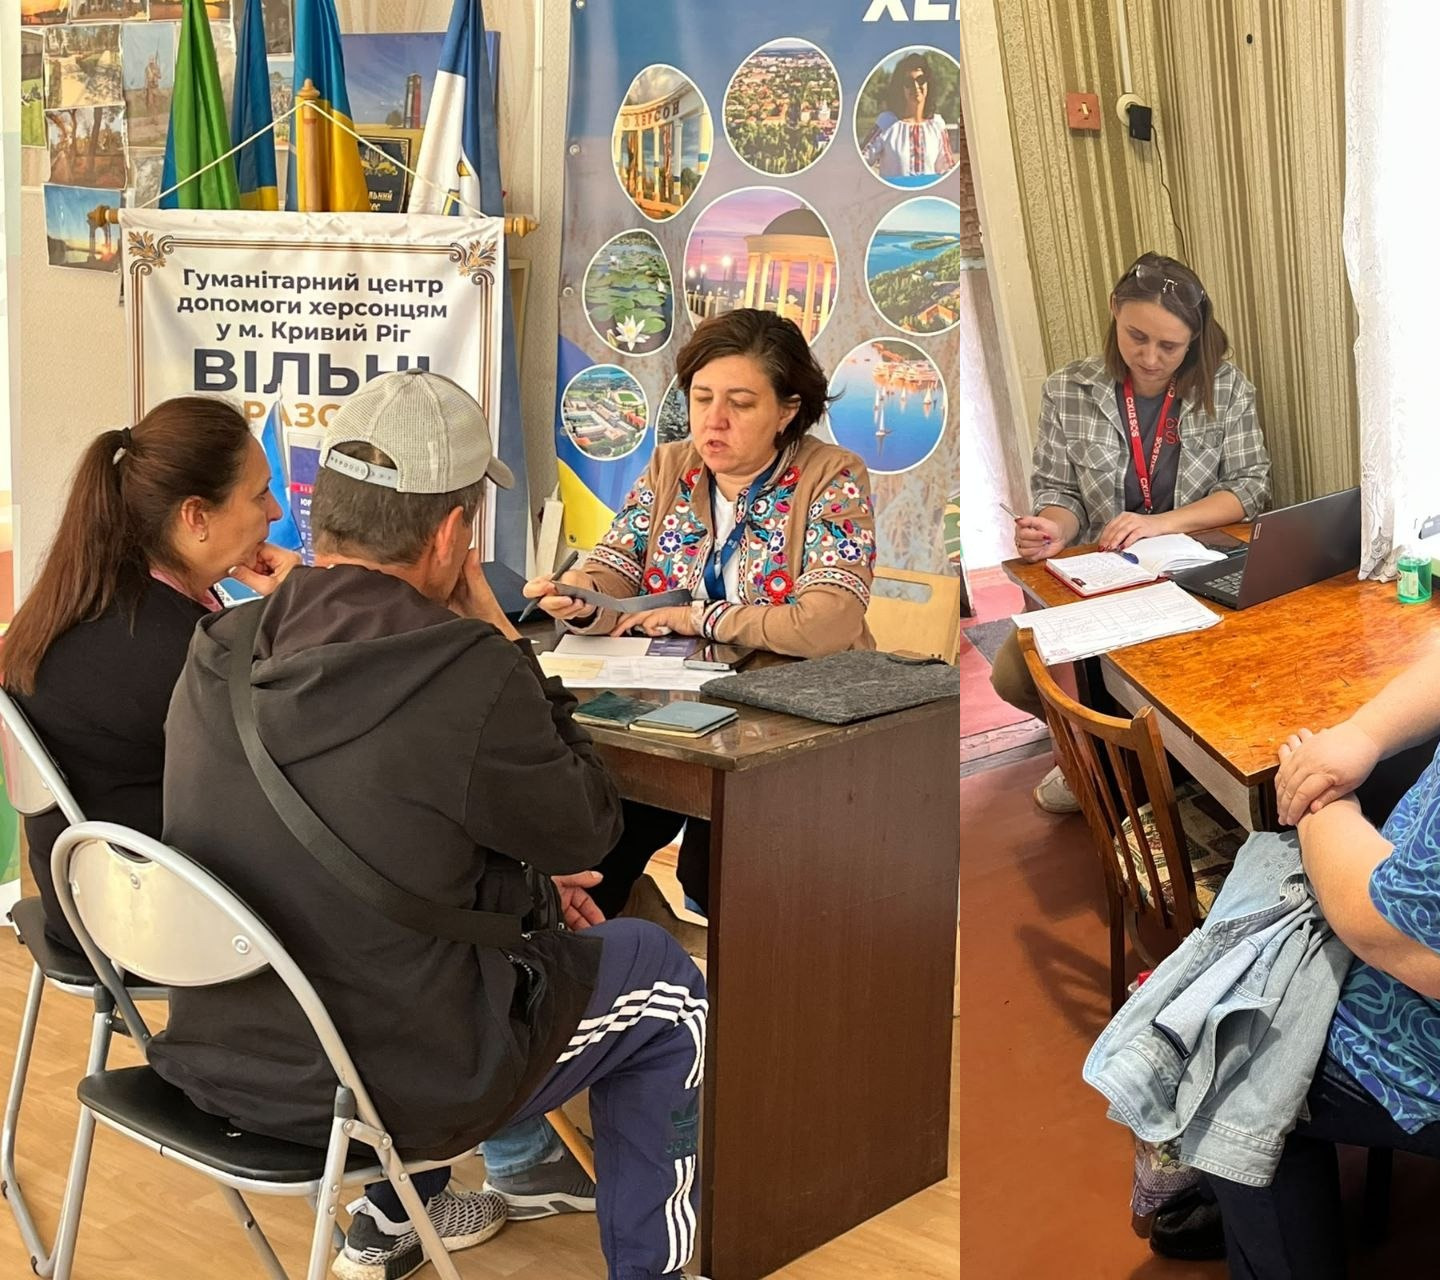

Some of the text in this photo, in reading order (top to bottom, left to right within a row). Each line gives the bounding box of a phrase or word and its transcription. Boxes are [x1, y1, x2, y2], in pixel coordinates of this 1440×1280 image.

[183, 269, 444, 297] Гуманітарний центр
[177, 296, 448, 320] допомоги херсонцям
[216, 322, 411, 344] у м. Кривий Ріг
[244, 401, 342, 428] РЗО
[1129, 418, 1140, 438] SOS
